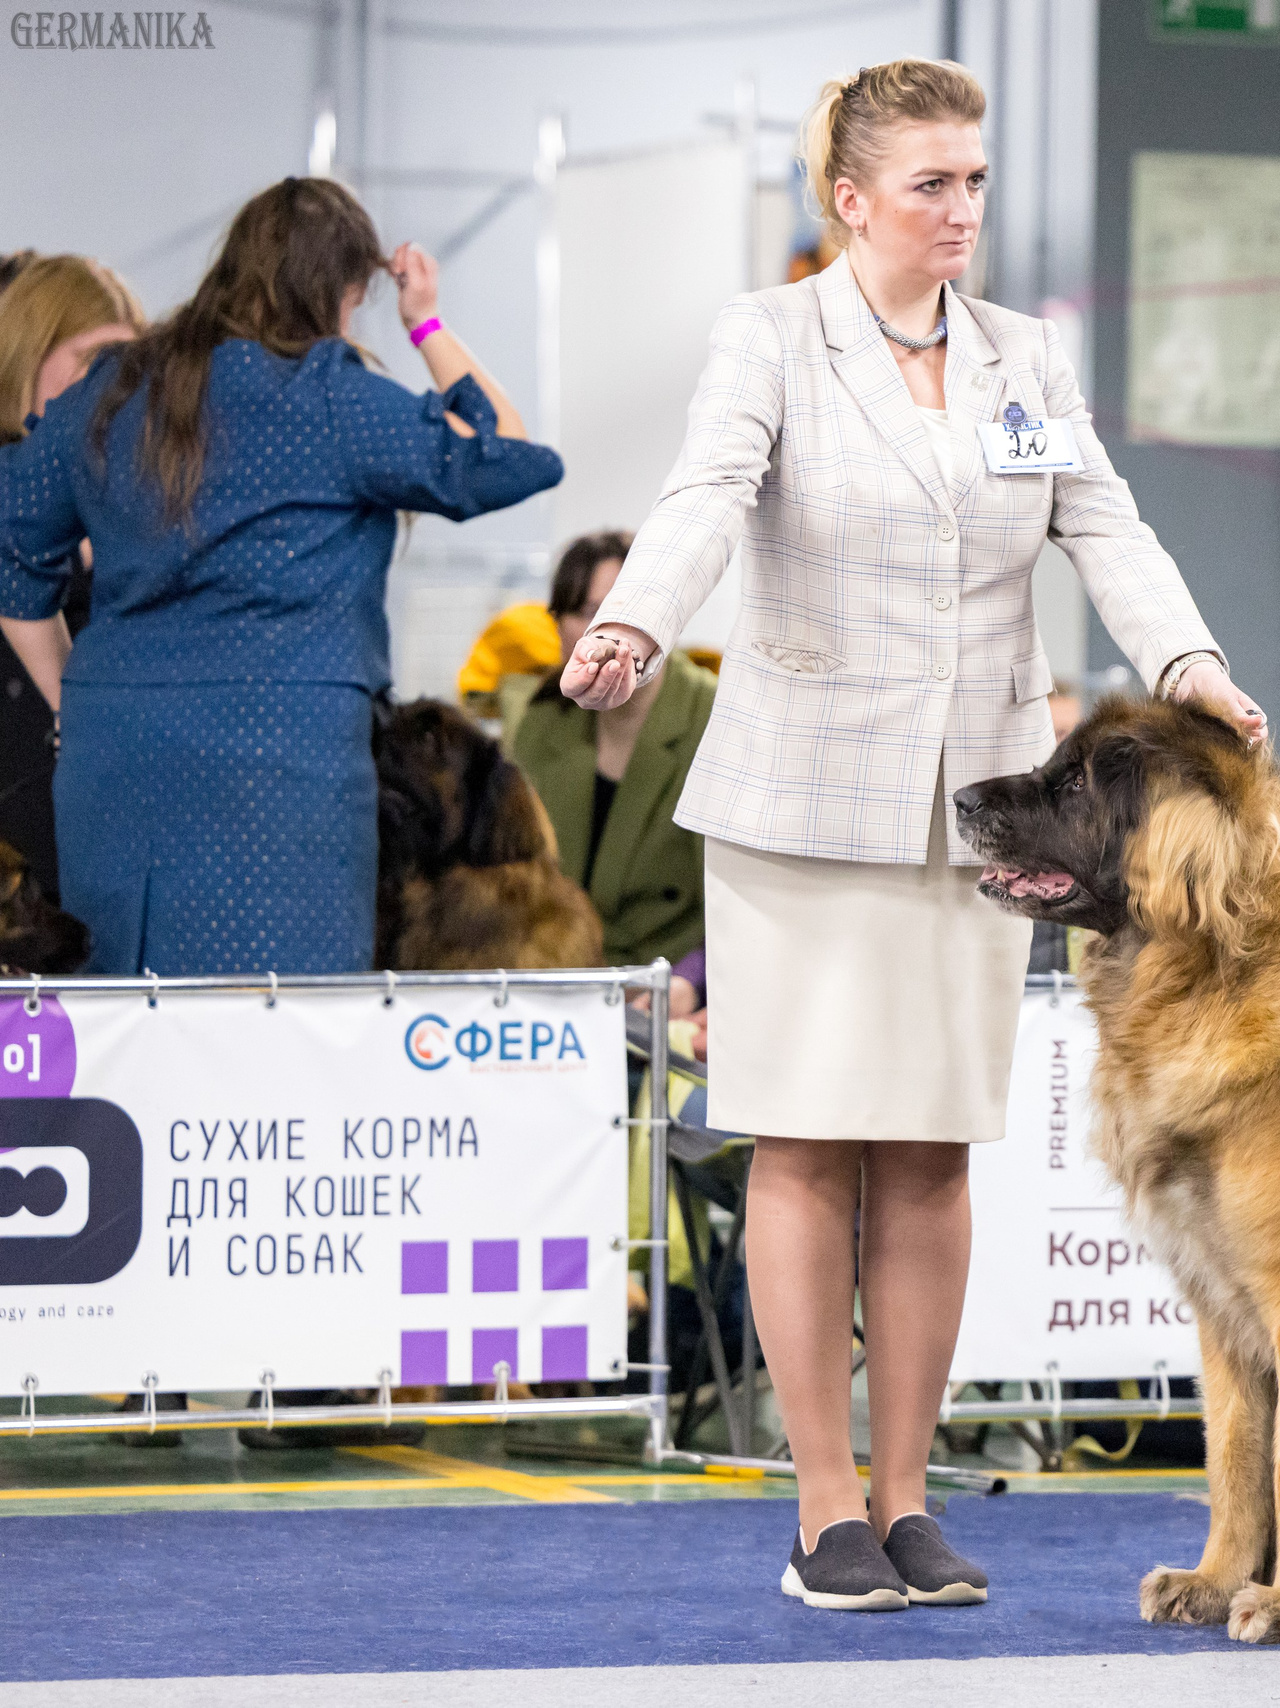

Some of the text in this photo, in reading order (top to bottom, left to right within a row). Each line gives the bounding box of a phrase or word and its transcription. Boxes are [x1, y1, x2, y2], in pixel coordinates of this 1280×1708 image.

[1008, 431, 1048, 459] 20
[404, 1013, 586, 1071] СФЕРА
[1049, 1039, 1069, 1169] PREMIUM
[170, 1117, 478, 1161] СУХИЕ КОРМА
[167, 1174, 422, 1228] ДЛЯ КОШЕК
[169, 1232, 364, 1277] И СОБАК
[38, 1303, 66, 1318] and
[77, 1305, 114, 1317] care
[1049, 1299, 1130, 1331] для
